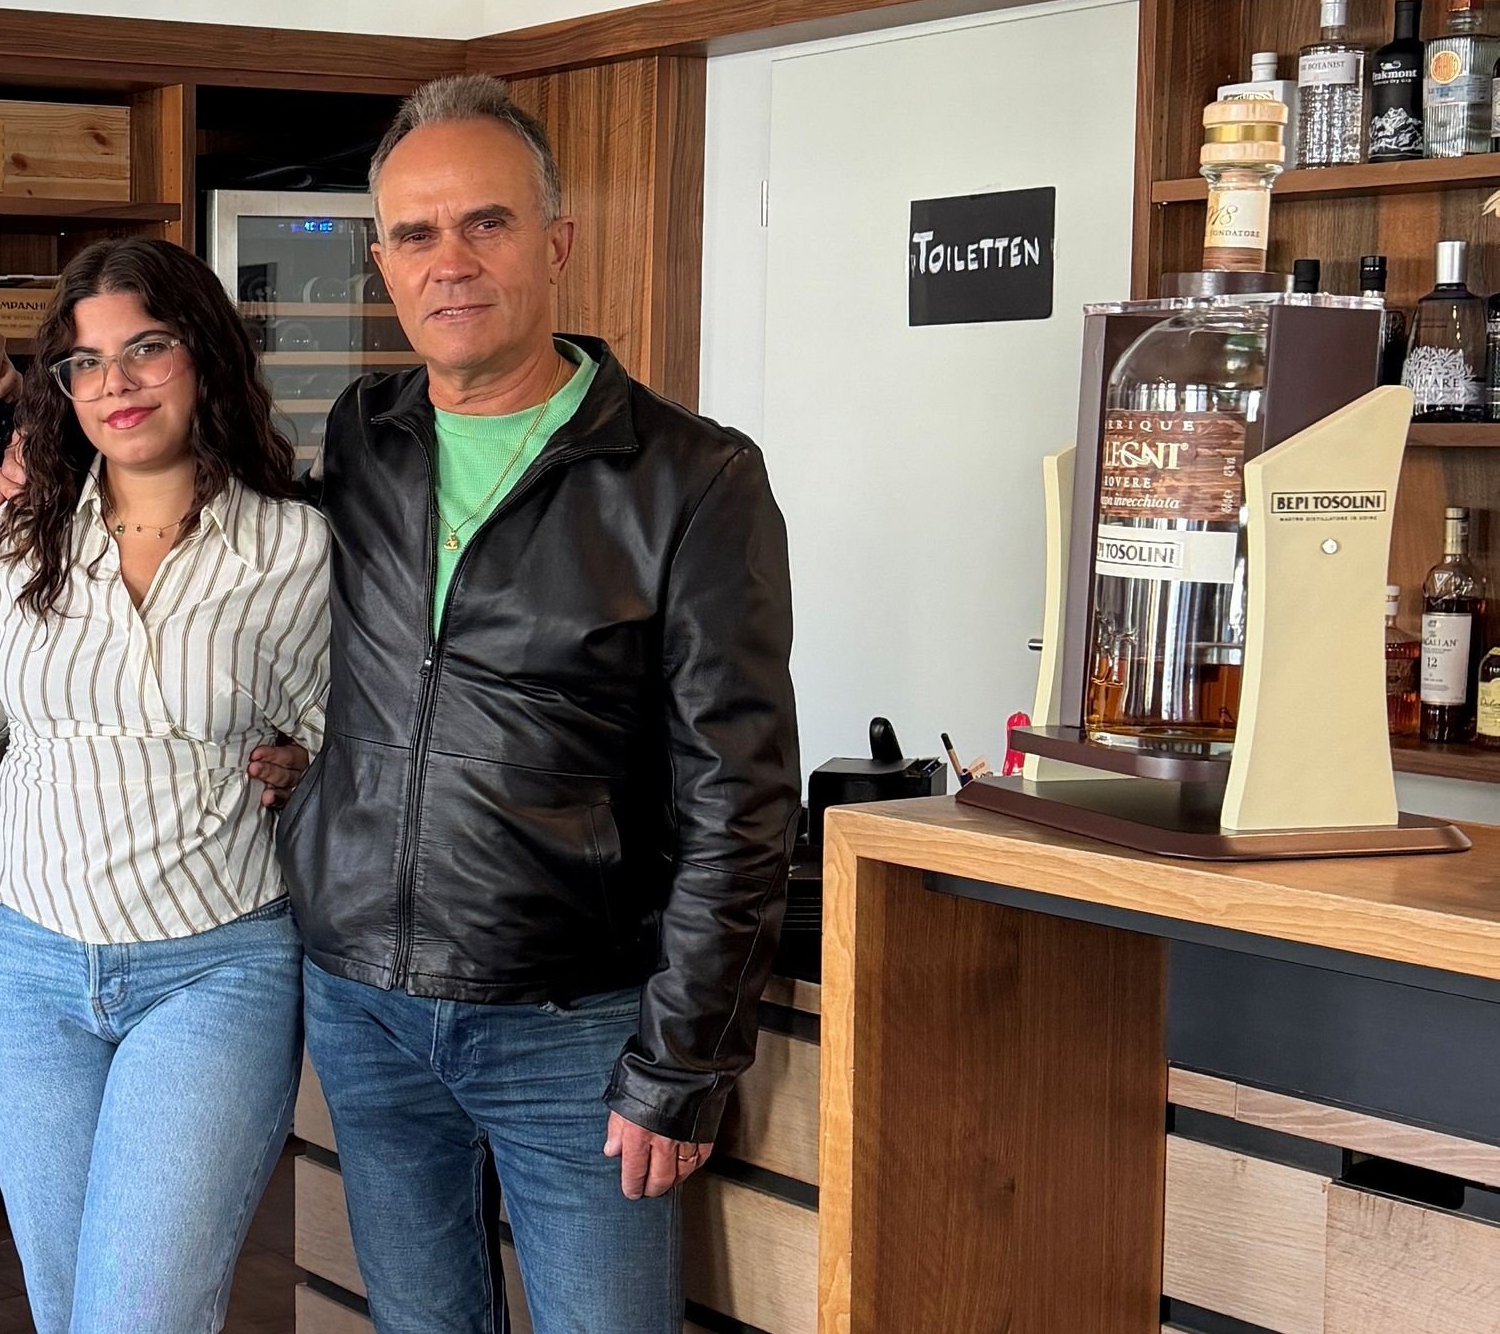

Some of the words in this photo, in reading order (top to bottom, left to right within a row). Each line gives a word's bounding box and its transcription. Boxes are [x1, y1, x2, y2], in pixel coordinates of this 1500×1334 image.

[1307, 60, 1345, 71] BOTANIST
[912, 230, 1040, 275] TOILETTEN
[1419, 377, 1461, 388] MARE
[1106, 420, 1195, 433] RRIQUE
[1113, 492, 1181, 509] invecchiata
[1277, 496, 1309, 510] BEPI
[1313, 495, 1381, 509] TOSOLINI
[1106, 543, 1175, 564] TOSOLINI
[1427, 657, 1438, 668] 12
